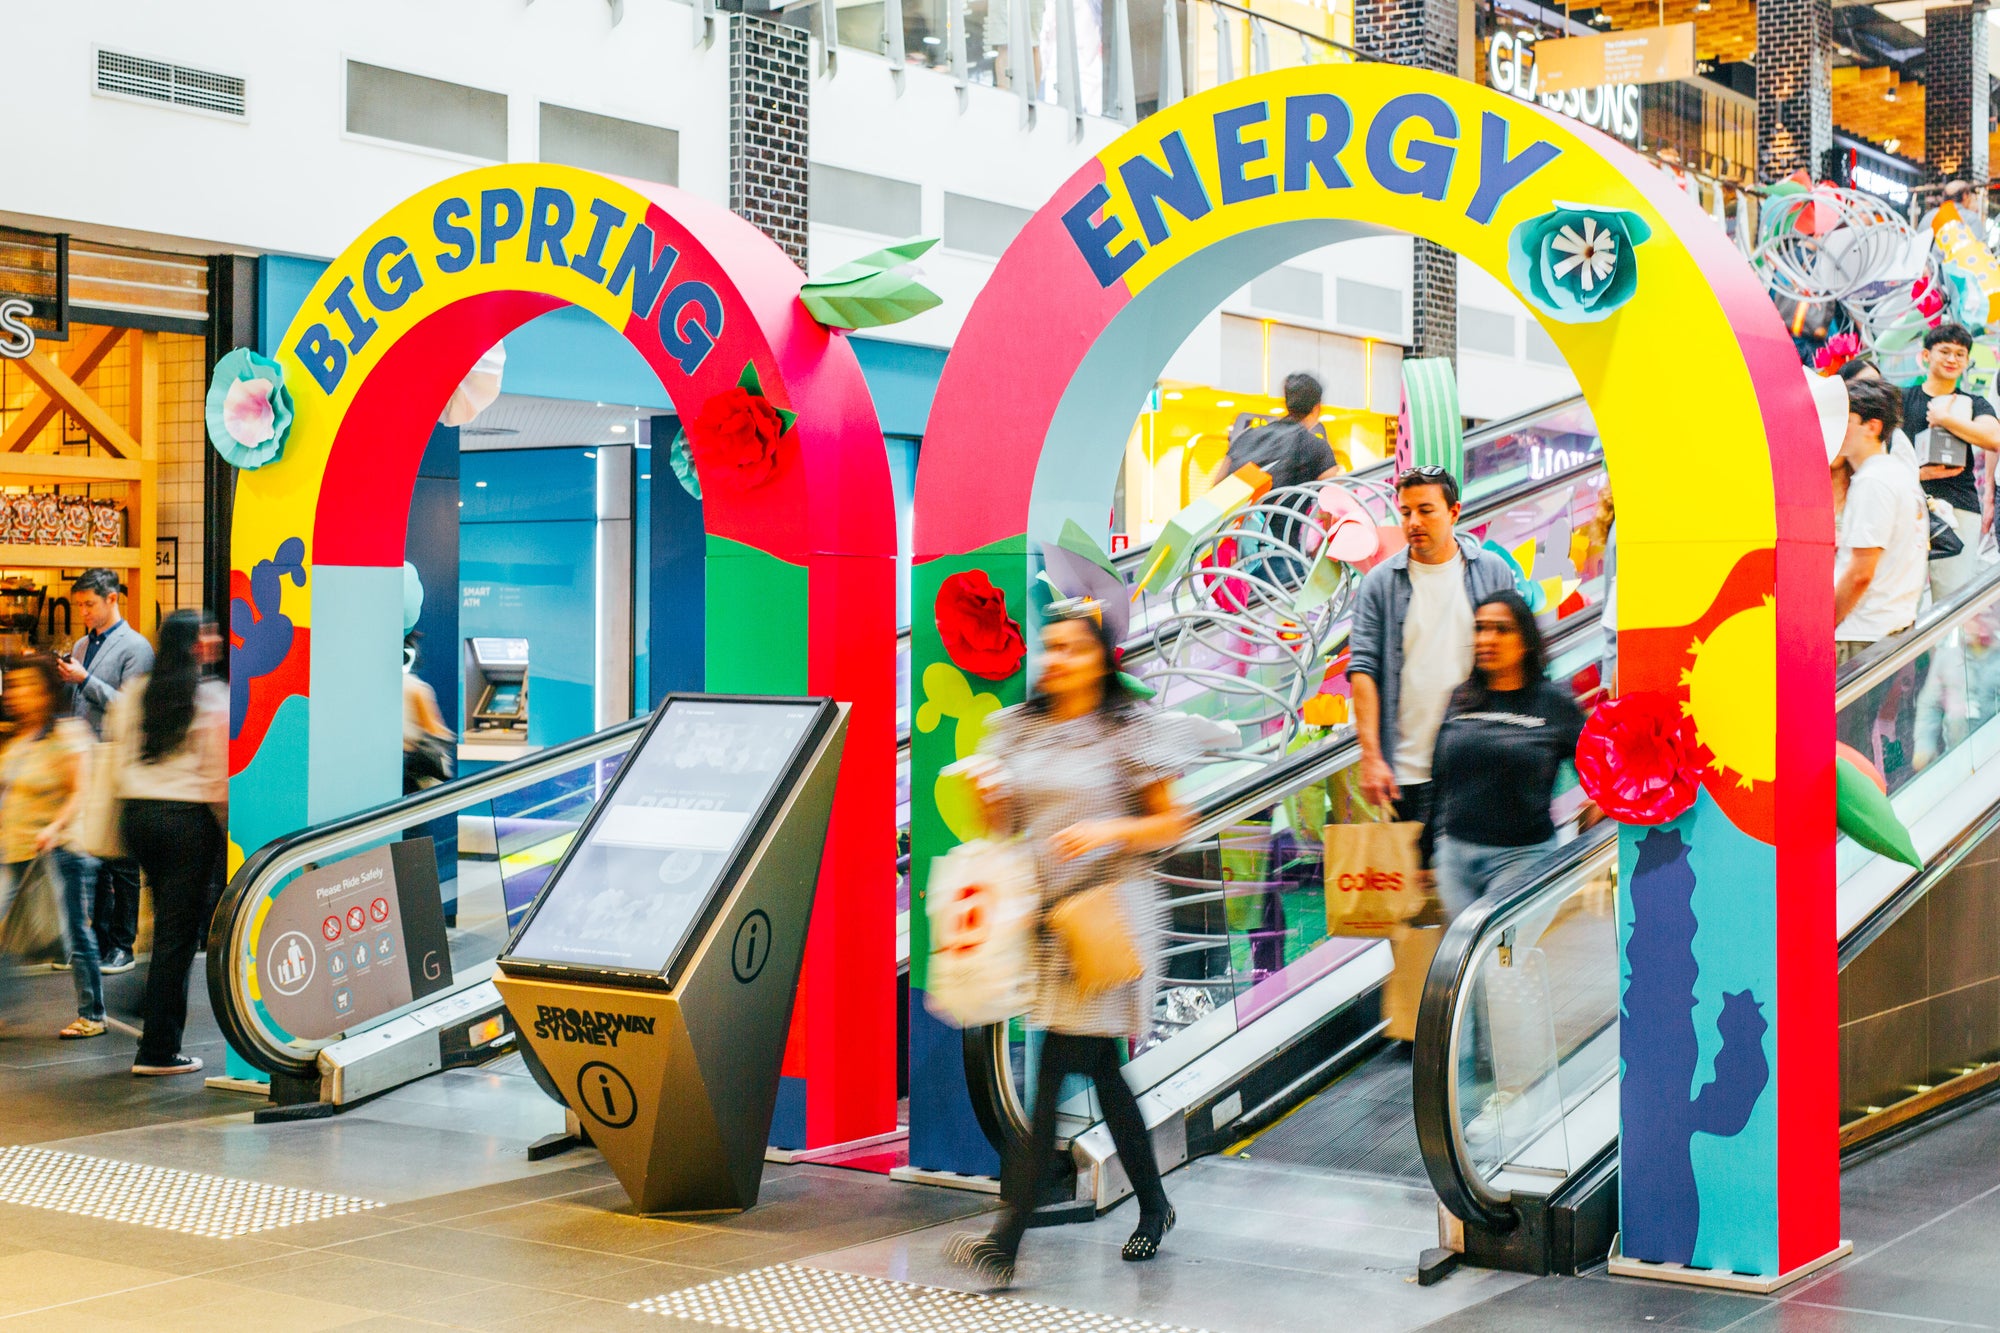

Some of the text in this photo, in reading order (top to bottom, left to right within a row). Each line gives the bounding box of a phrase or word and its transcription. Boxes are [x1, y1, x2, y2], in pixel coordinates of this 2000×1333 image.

[1061, 93, 1564, 289] ENERGY
[295, 187, 724, 396] BIG SPRING
[463, 586, 491, 597] SMART
[463, 598, 481, 607] ATM
[316, 867, 383, 899] Please Ride Safely
[1338, 867, 1404, 892] coles
[423, 951, 441, 980] G
[534, 1020, 619, 1047] SYDNEY
[536, 1005, 656, 1034] BROADWAY
